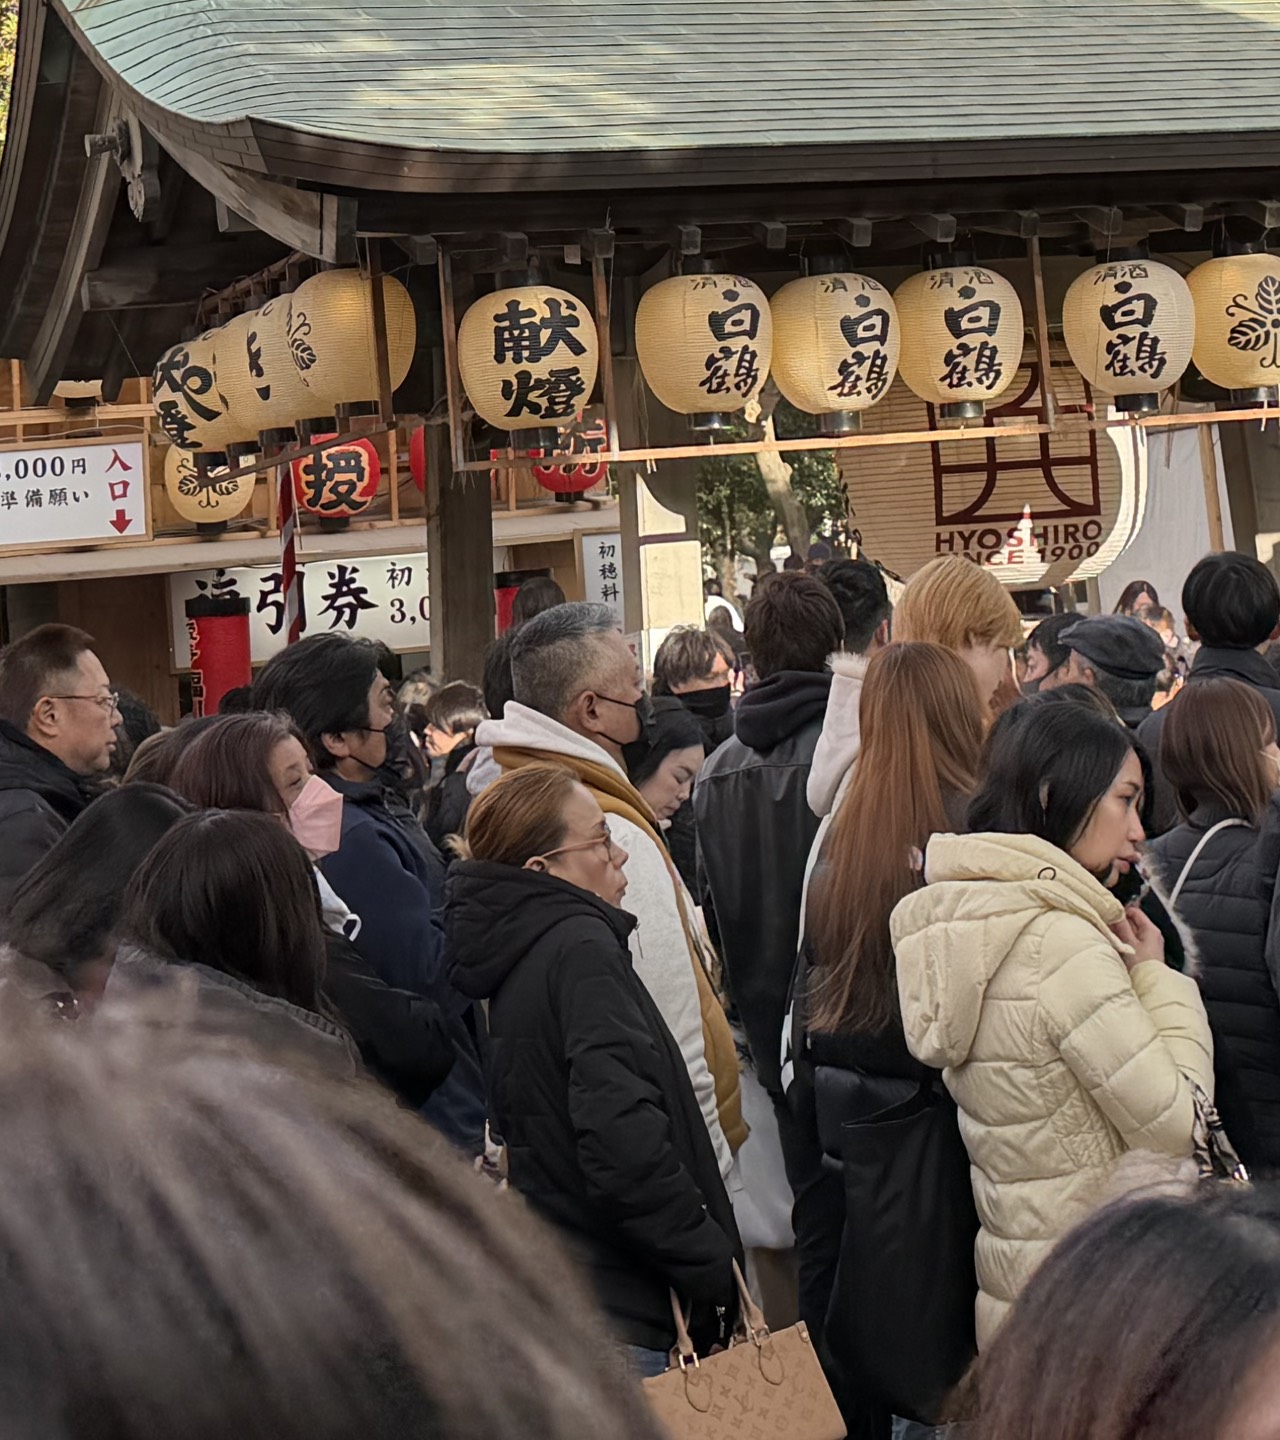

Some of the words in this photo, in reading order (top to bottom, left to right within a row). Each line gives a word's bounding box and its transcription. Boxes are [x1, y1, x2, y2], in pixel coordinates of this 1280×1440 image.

[1094, 264, 1149, 285] 清酒
[699, 289, 761, 397] 白鶴
[829, 293, 890, 400] 白鶴
[939, 285, 1003, 391] 白鶴
[1099, 280, 1166, 380] 白鶴
[105, 448, 134, 502] 入口
[935, 519, 1102, 554] HYOSHIRO
[1037, 541, 1101, 564] 1900
[597, 541, 620, 602] 初穂料
